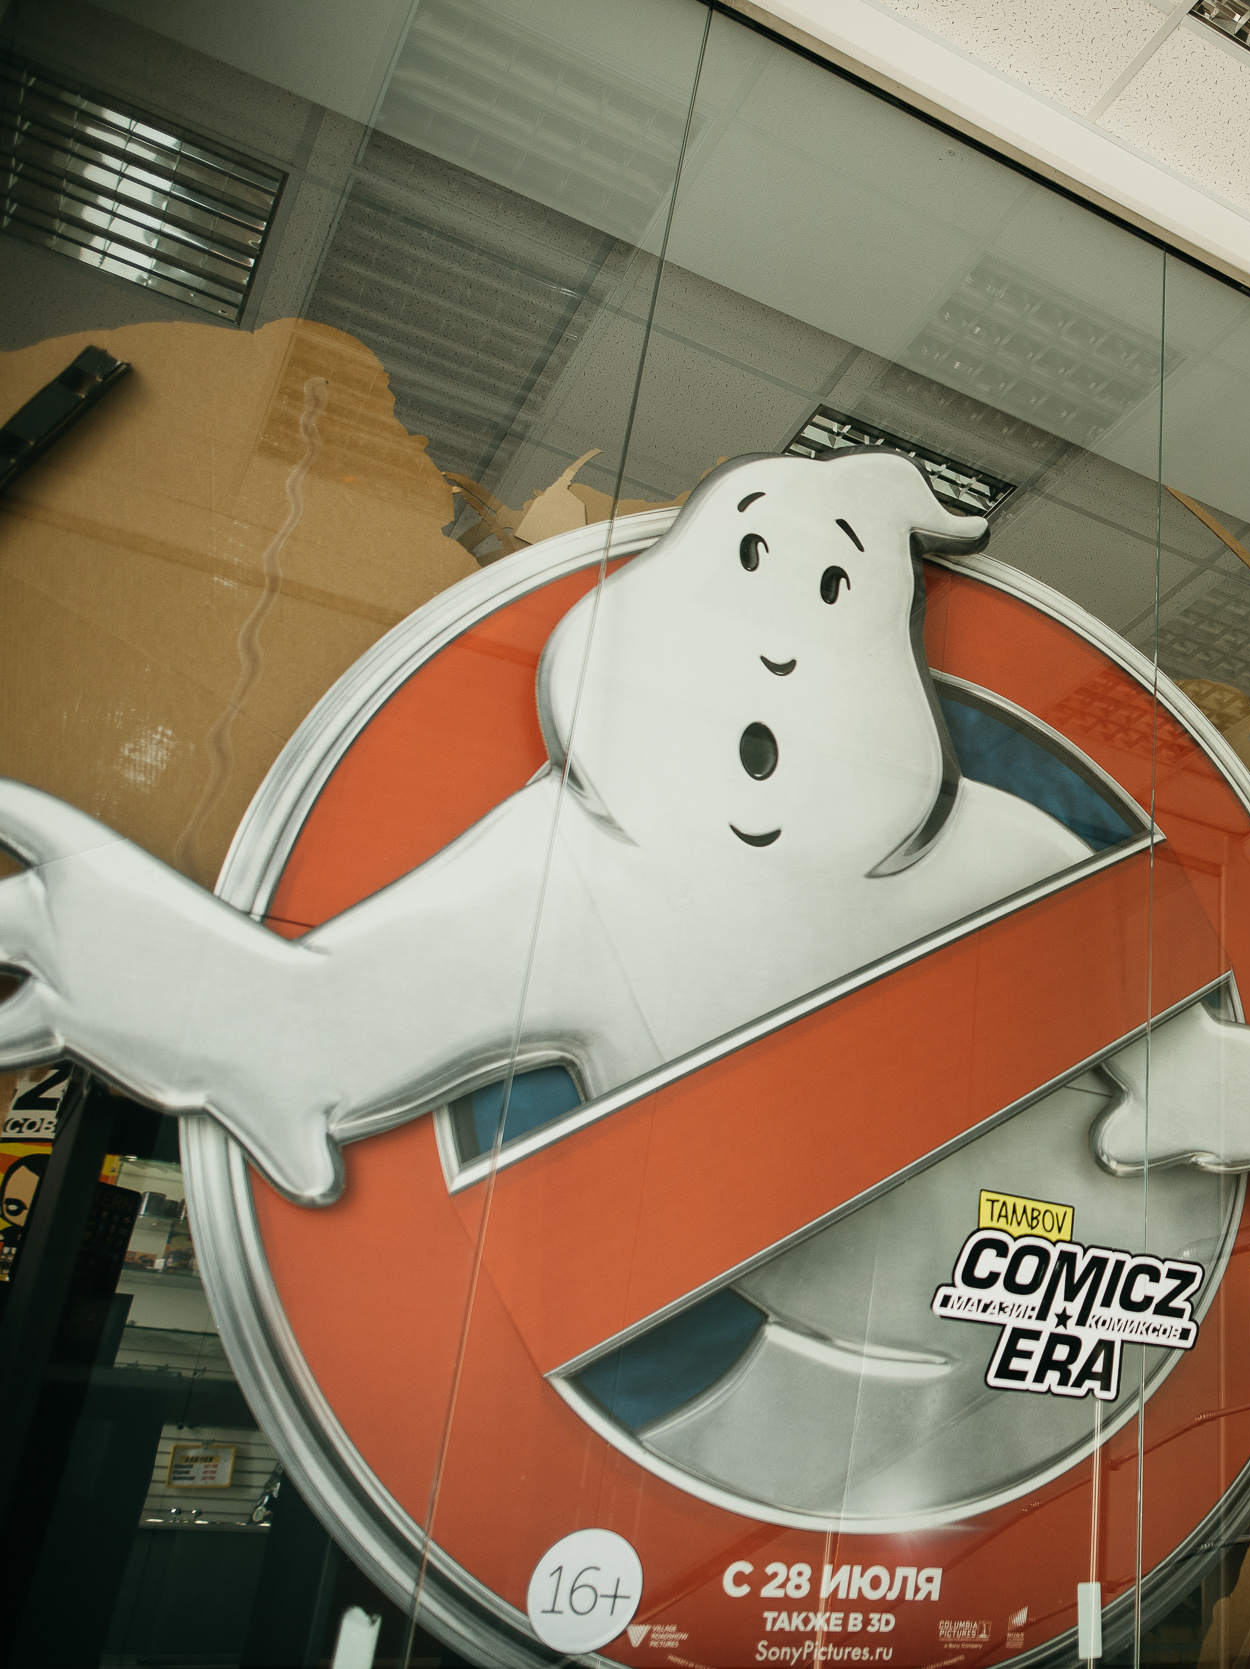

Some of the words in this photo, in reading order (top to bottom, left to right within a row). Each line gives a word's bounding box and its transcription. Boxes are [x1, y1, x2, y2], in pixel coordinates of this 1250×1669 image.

[986, 1198, 1069, 1234] TAMBOV
[961, 1238, 1198, 1327] COMICZ
[948, 1295, 1037, 1321] МАГАЗИН
[1087, 1313, 1182, 1340] КОМИКСОВ
[994, 1326, 1117, 1392] ERA
[541, 1565, 632, 1616] 16+
[760, 1561, 813, 1599] 28
[820, 1564, 943, 1601] ИЮЛЯ
[763, 1611, 845, 1632] ТАКЖЕ
[867, 1613, 896, 1633] 3D
[939, 1620, 978, 1630] COLUMBIA
[939, 1629, 977, 1638] PICTURES
[649, 1640, 680, 1648] PICTURES
[755, 1640, 893, 1666] SonyPictures.ru
